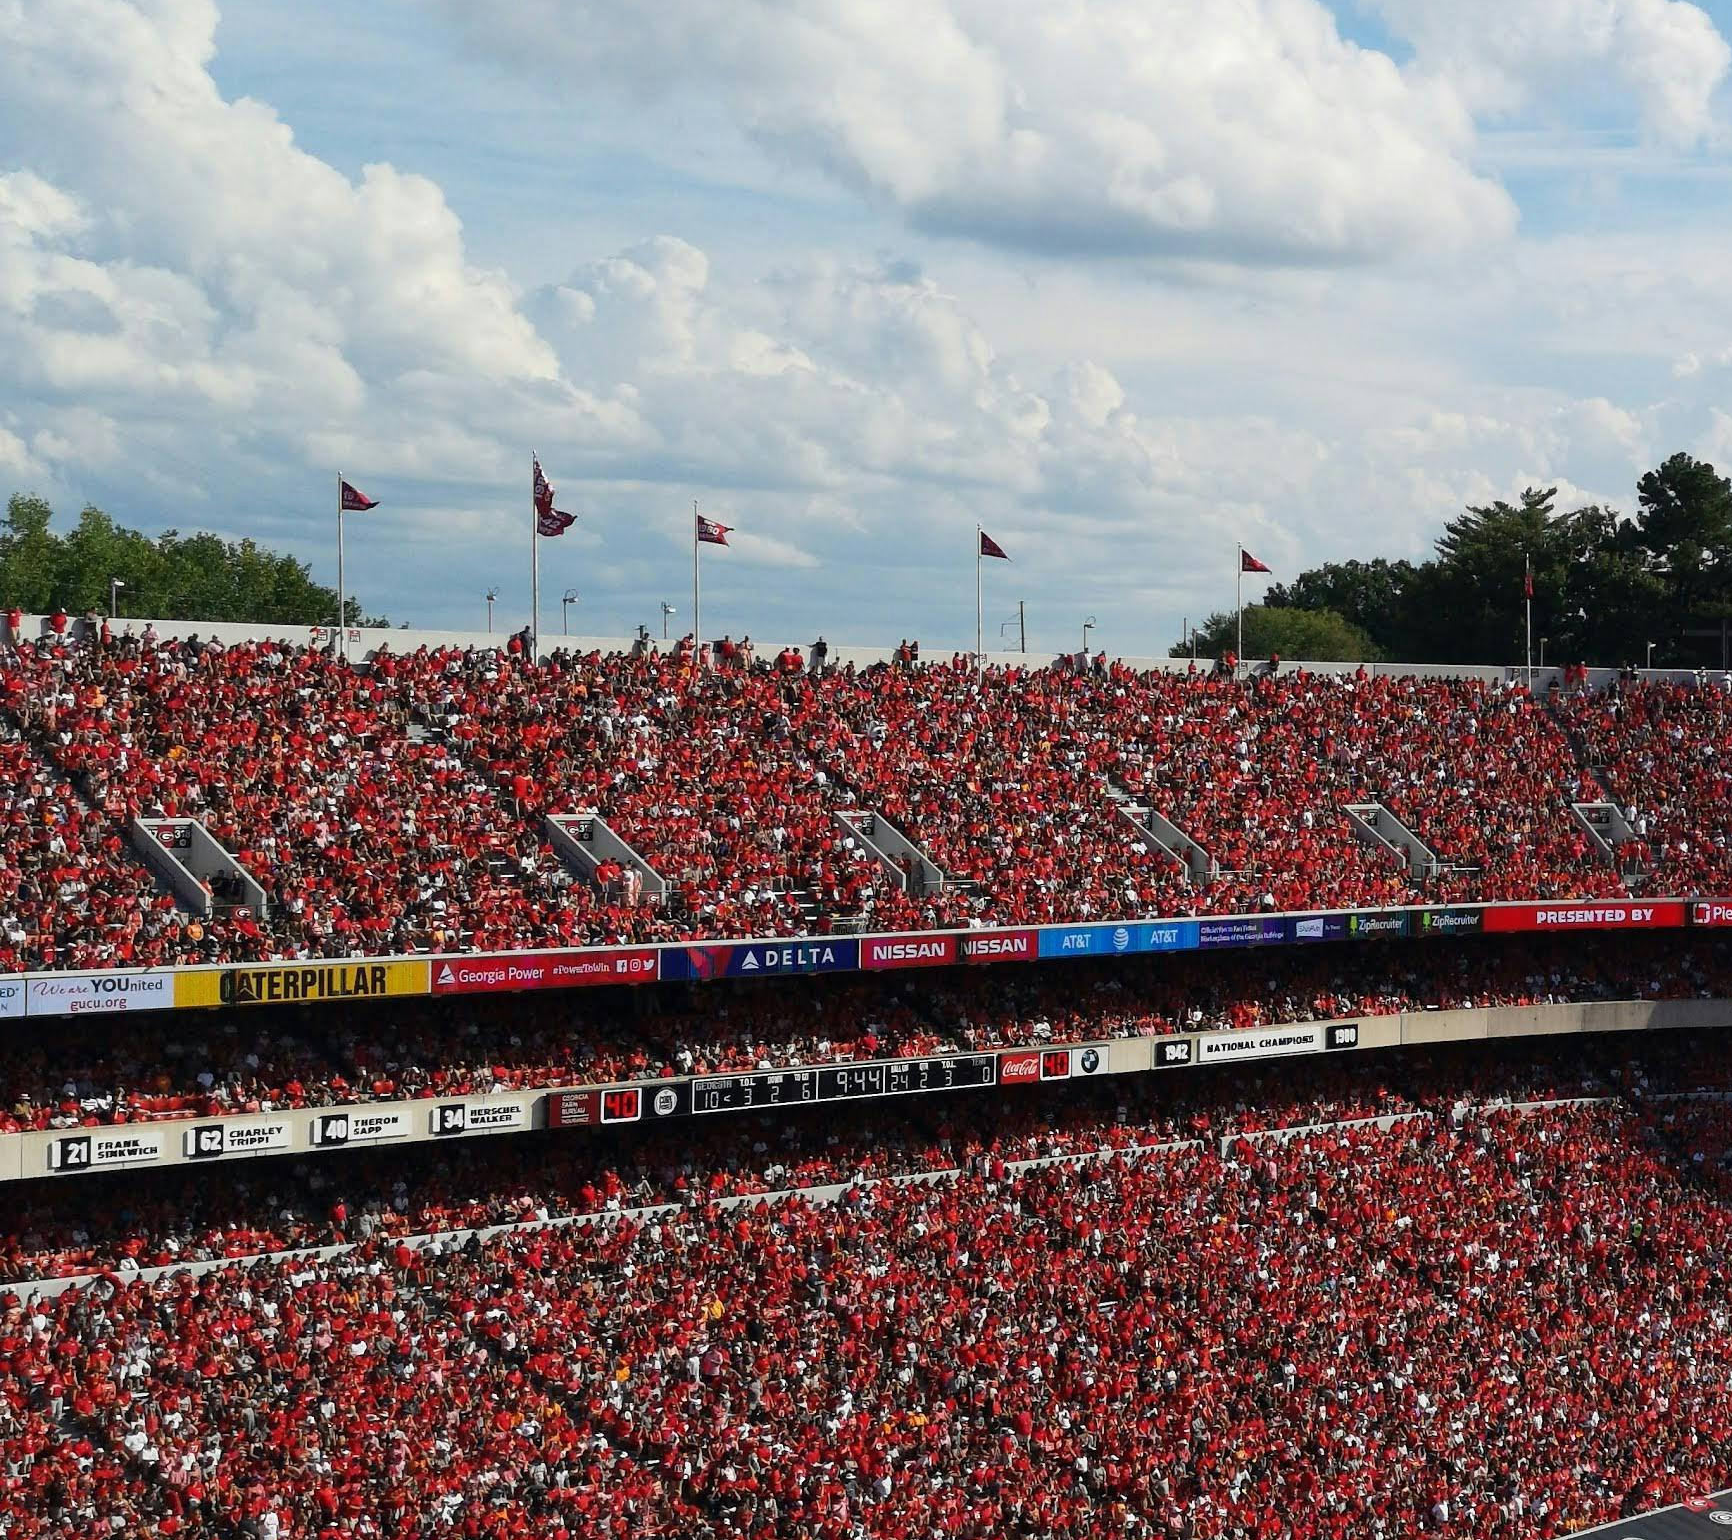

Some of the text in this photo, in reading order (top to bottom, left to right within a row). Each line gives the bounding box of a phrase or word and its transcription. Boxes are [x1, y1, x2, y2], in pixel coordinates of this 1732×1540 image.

[1430, 914, 1479, 928] ZipRecruiter
[1536, 908, 1653, 924] PRESENTED BY
[1358, 918, 1403, 933] ZipRecruiter
[1062, 934, 1092, 949] AT&T
[1150, 929, 1178, 945] AT&T
[873, 942, 945, 960] NISSAN
[960, 937, 1027, 956] NISSAN
[766, 947, 835, 967] DELTA
[459, 966, 544, 985] Georgia Power
[90, 978, 163, 993] YOUnited
[220, 965, 386, 1003] CATERPILLAR
[70, 997, 127, 1012] gucu.org
[1165, 1043, 1189, 1061] 1942
[1207, 1039, 1255, 1053] NATIONAL
[1043, 1051, 1067, 1077] 40
[704, 1066, 991, 1109] 10 3 2 6 24 2 3 0
[837, 1070, 881, 1093] 9:44
[470, 1106, 522, 1117] HERSCHEL
[606, 1091, 637, 1118] 40
[353, 1116, 399, 1127] THERON
[444, 1108, 464, 1129] 34
[470, 1114, 513, 1125] WALKER
[229, 1126, 283, 1138] CHARLEY
[325, 1119, 347, 1140] 40
[353, 1125, 382, 1136] SAPP
[97, 1139, 141, 1151] FRANK
[200, 1130, 222, 1151] 62
[229, 1136, 269, 1147] TRIPPI
[67, 1141, 88, 1164] 21
[97, 1146, 158, 1159] SINKWICH
